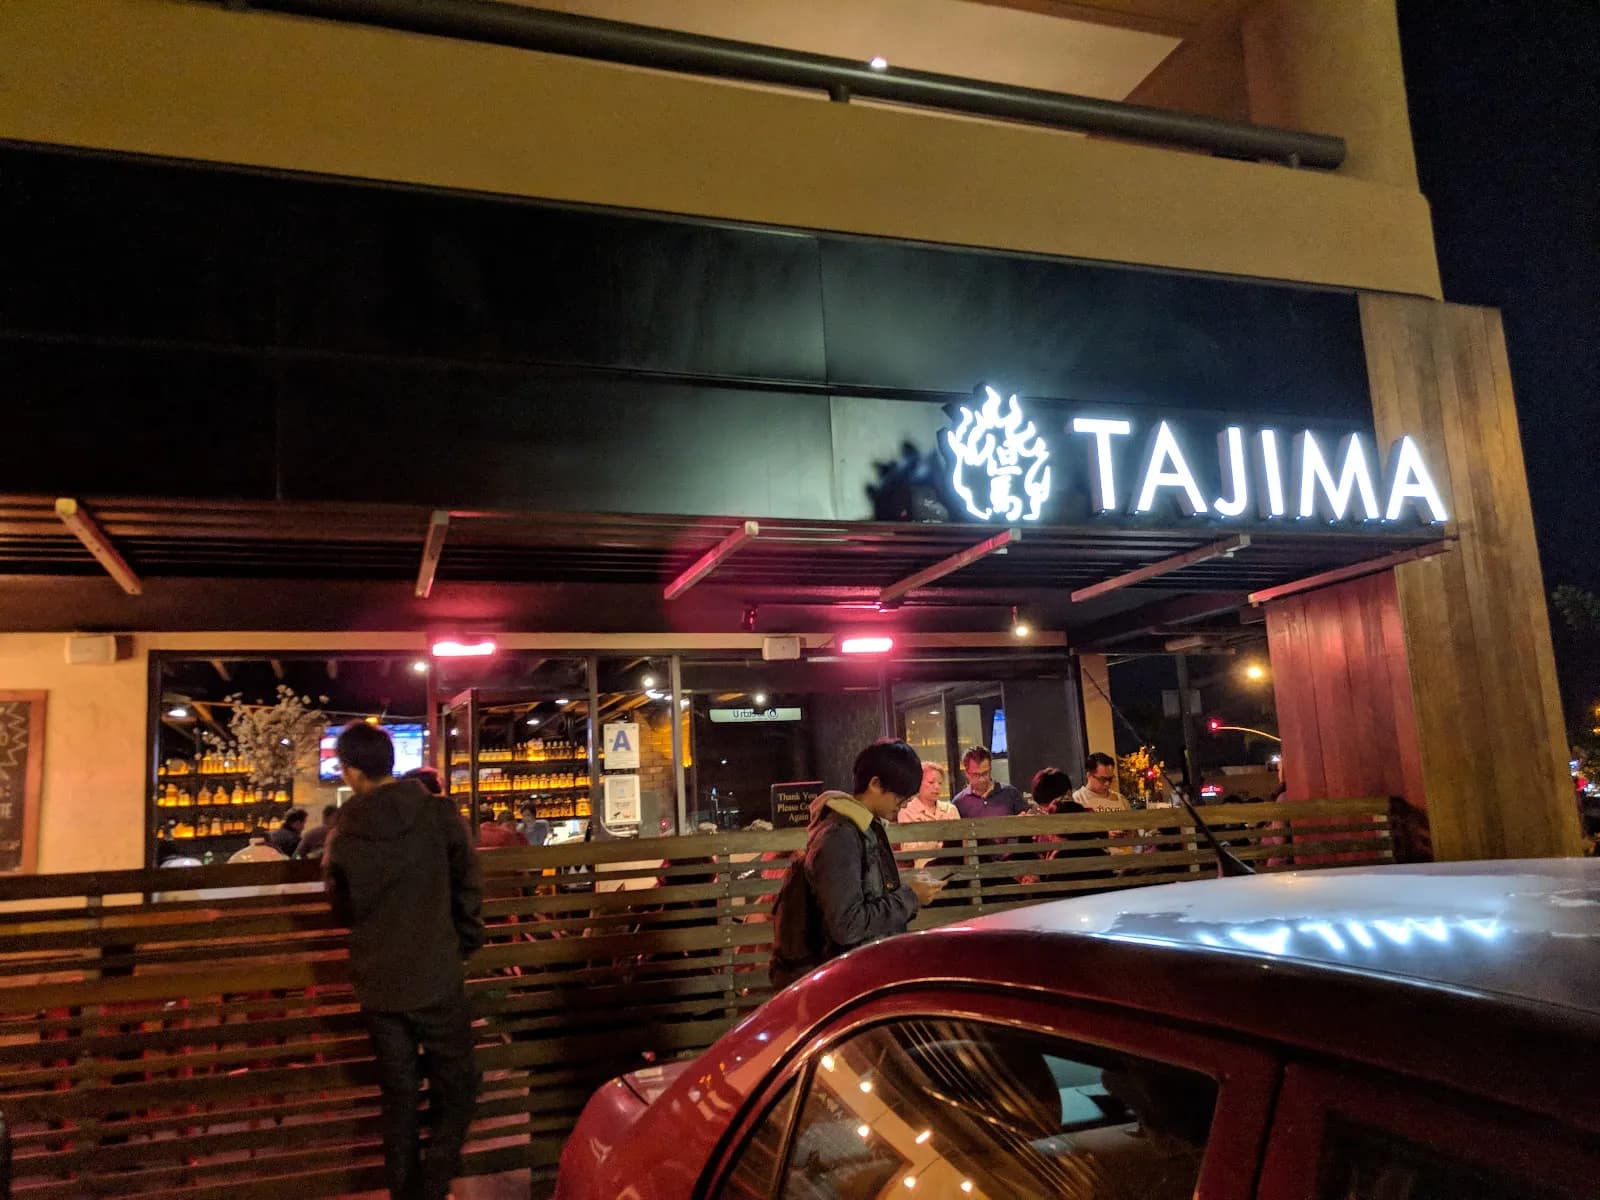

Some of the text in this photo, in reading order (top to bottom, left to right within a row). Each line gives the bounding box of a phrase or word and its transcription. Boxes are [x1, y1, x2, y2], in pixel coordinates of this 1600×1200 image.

[1073, 417, 1449, 523] TAJIMA
[612, 730, 631, 751] A
[778, 792, 800, 801] Thank
[777, 803, 799, 813] Please
[789, 813, 809, 823] Again
